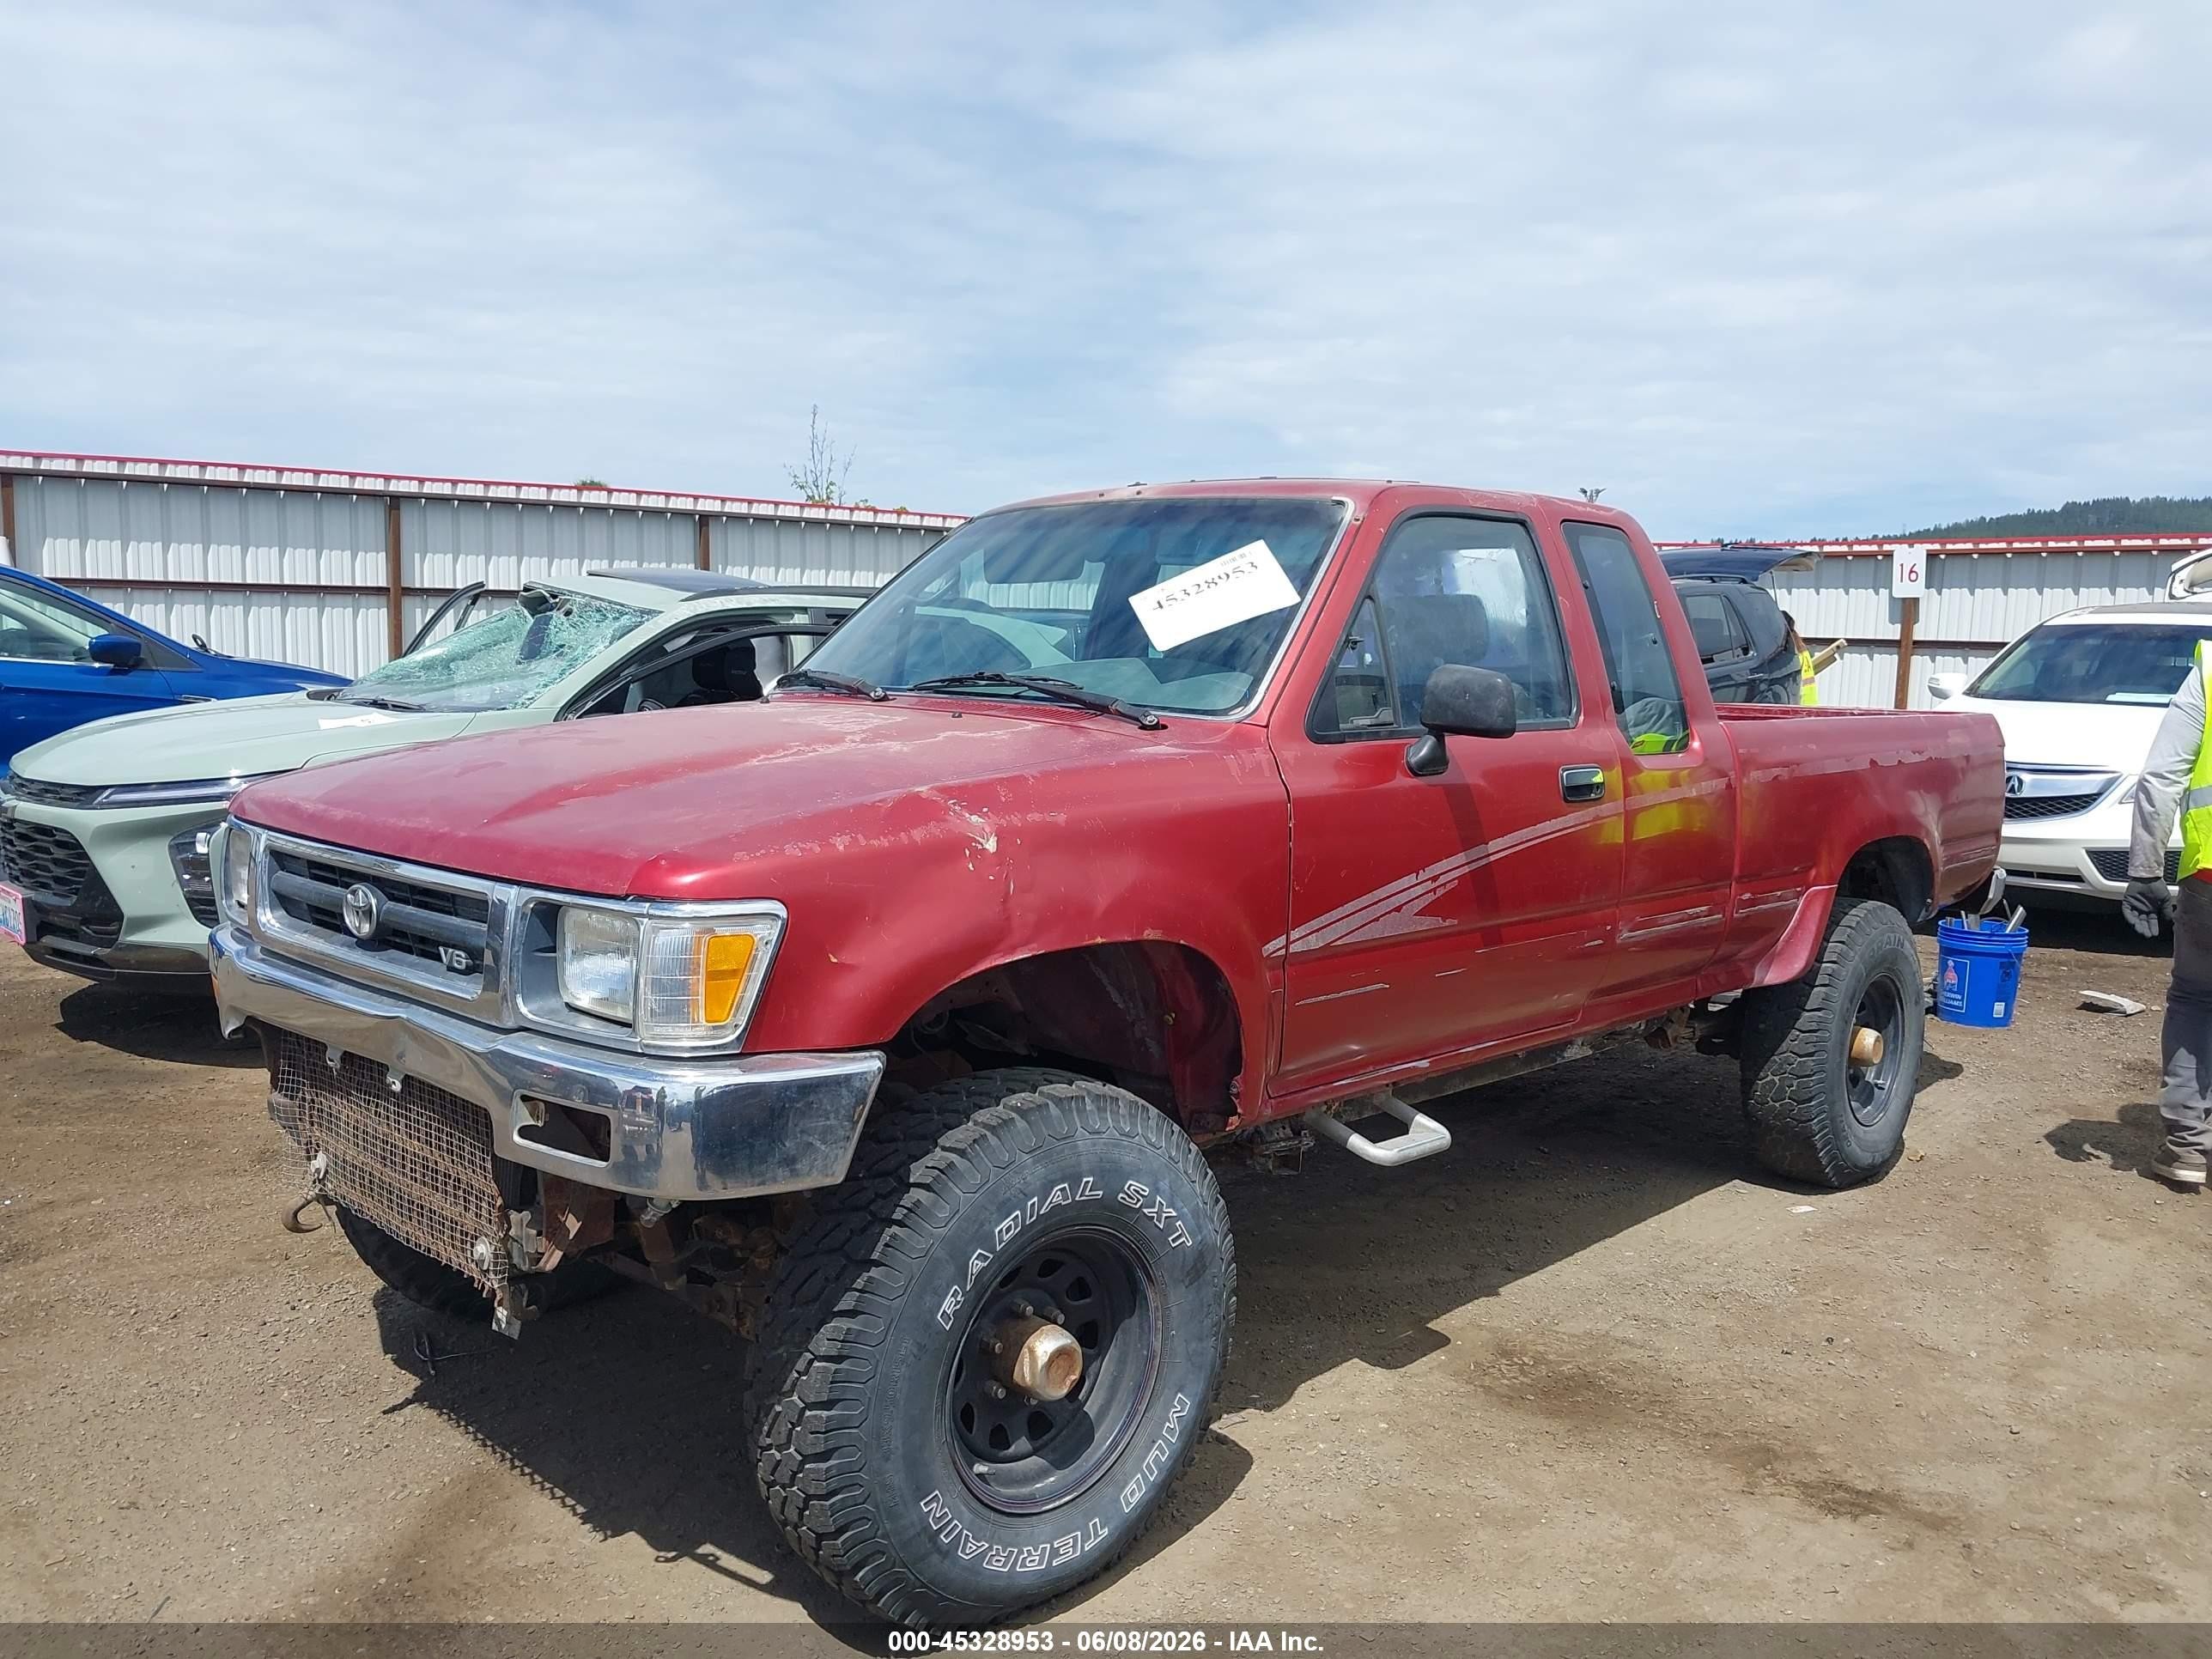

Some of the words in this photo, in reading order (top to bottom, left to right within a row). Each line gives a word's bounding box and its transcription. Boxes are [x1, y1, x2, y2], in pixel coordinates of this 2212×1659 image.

[1152, 561, 1259, 611] 45328953
[1899, 562, 1919, 583] 16
[438, 945, 466, 970] V6
[938, 1177, 1103, 1330] RADIAL
[1118, 1180, 1193, 1249] SXT
[1121, 1394, 1190, 1513] MUD
[921, 1490, 1109, 1572] TERRAIN
